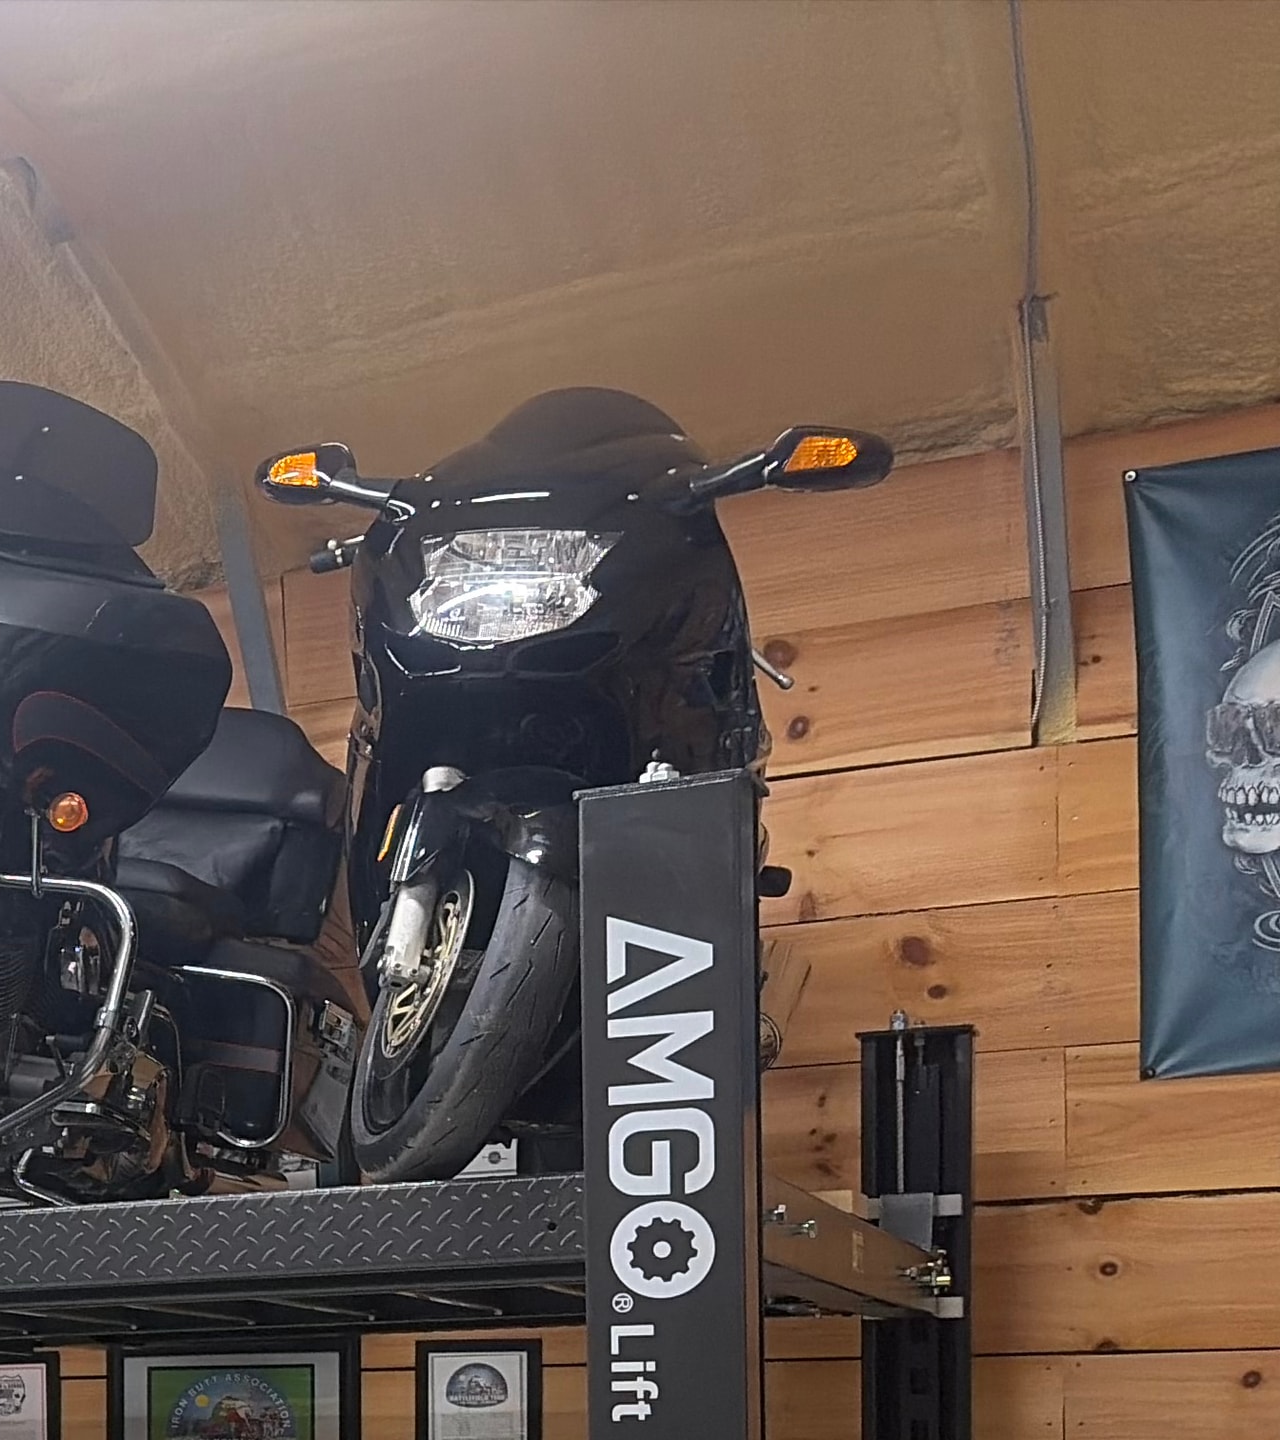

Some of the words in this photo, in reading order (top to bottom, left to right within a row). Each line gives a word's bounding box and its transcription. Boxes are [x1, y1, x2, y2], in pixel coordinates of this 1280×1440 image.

[606, 916, 716, 1299] AMGO
[171, 1398, 188, 1428] IRON
[187, 1375, 217, 1397] BUTT
[225, 1373, 292, 1429] ASSOCIATION
[611, 1324, 659, 1422] Lift
